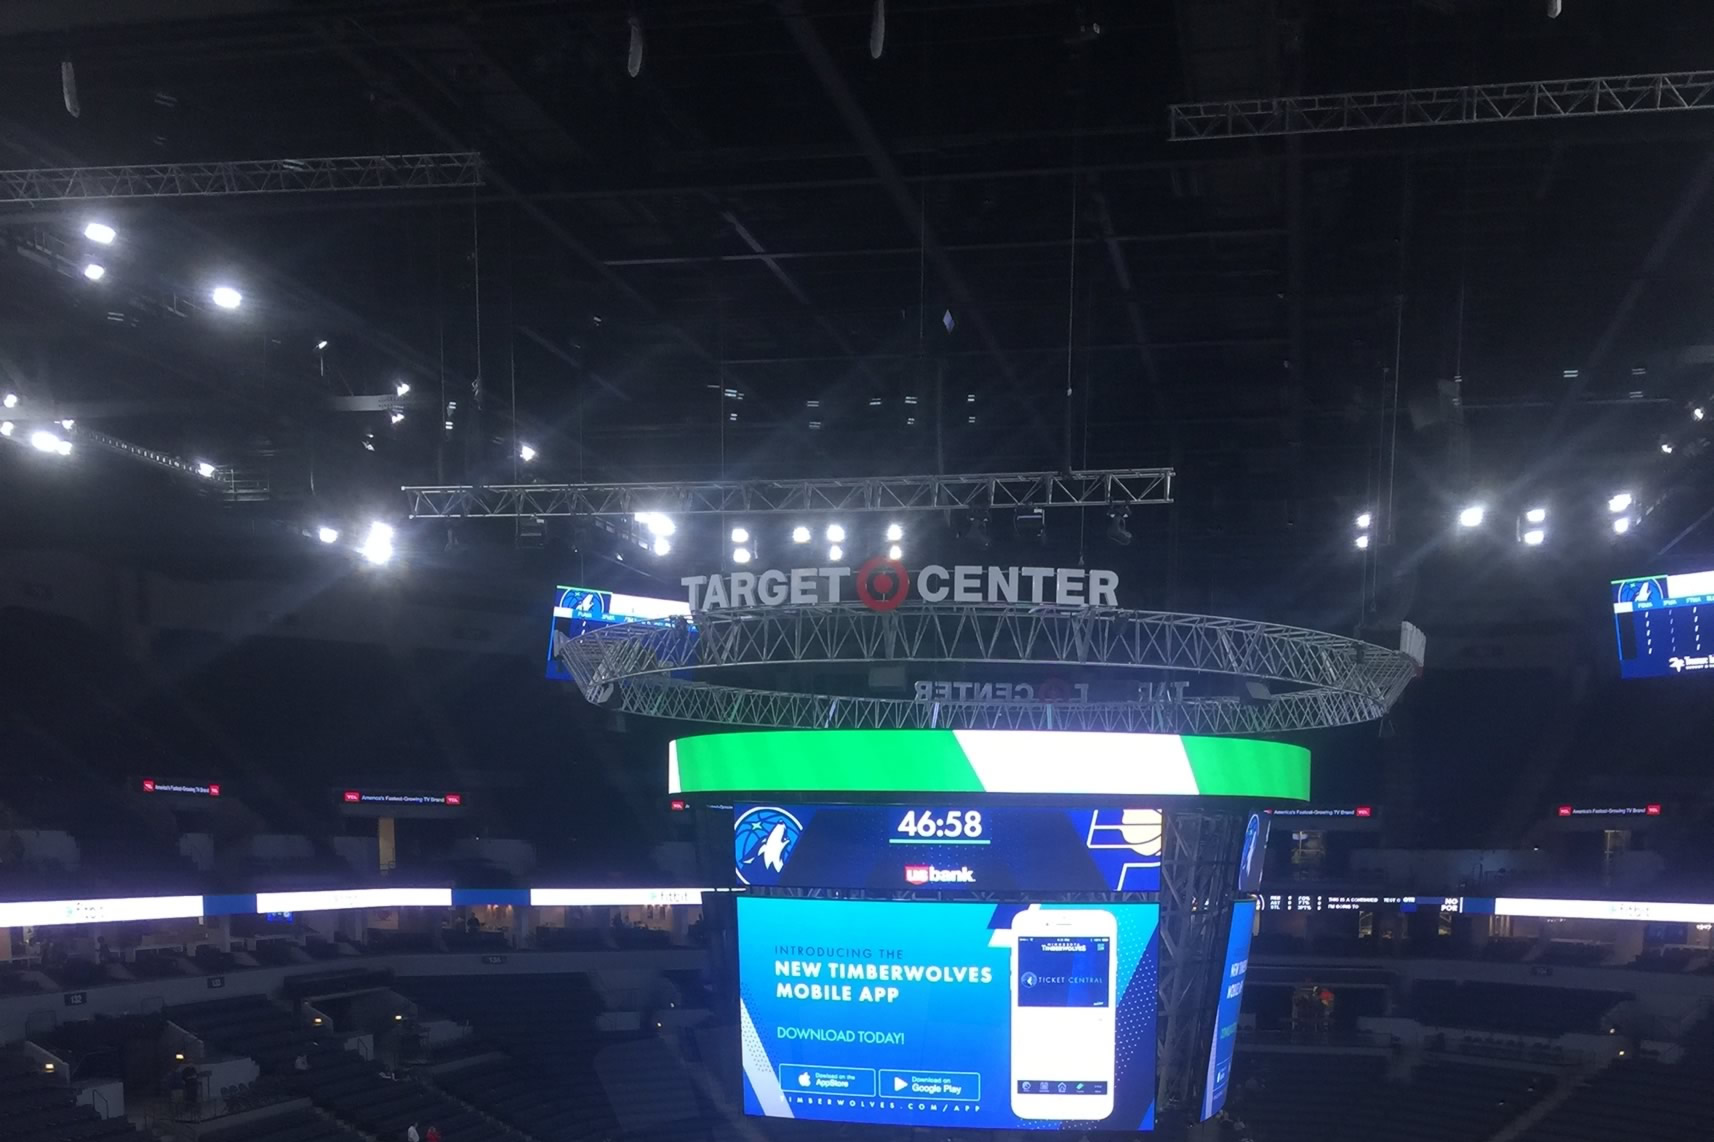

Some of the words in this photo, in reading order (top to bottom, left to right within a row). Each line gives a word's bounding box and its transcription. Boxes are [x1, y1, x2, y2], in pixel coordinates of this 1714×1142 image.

[681, 567, 851, 612] TARGET
[917, 565, 1119, 606] CENTER
[897, 810, 982, 837] 46:58
[774, 945, 873, 959] INTRODUCING
[879, 948, 904, 960] THE
[775, 960, 822, 978] NEW
[828, 962, 993, 984] TIMBERWOLVES
[1038, 976, 1065, 984] TICKET
[1067, 976, 1103, 984] CENTRAL
[776, 982, 852, 1002] MOBILE
[859, 985, 900, 1003] APP
[777, 1026, 856, 1043] DOWNLOAD
[857, 1030, 905, 1046] TODAY!
[911, 1075, 942, 1084] Download
[911, 1083, 942, 1094] Google
[943, 1084, 962, 1095] Play
